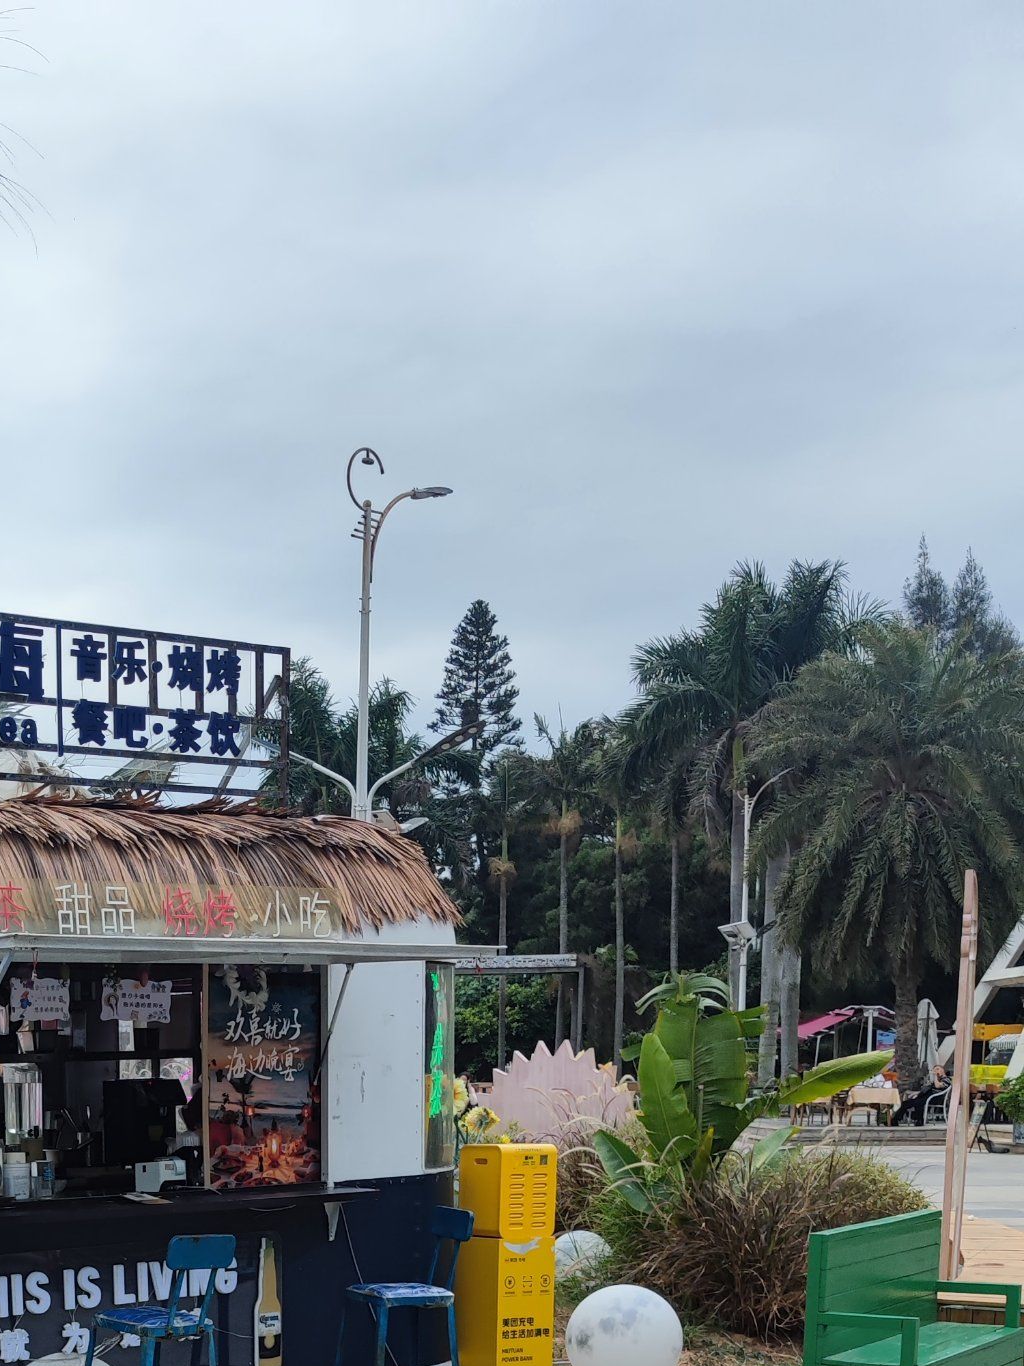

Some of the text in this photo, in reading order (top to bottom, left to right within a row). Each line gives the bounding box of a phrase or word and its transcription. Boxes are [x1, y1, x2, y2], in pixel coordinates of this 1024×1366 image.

[55, 883, 136, 935] 甜品
[262, 889, 332, 938] 小吃
[224, 1044, 301, 1082] 海边晚宴
[63, 1266, 103, 1311] IS
